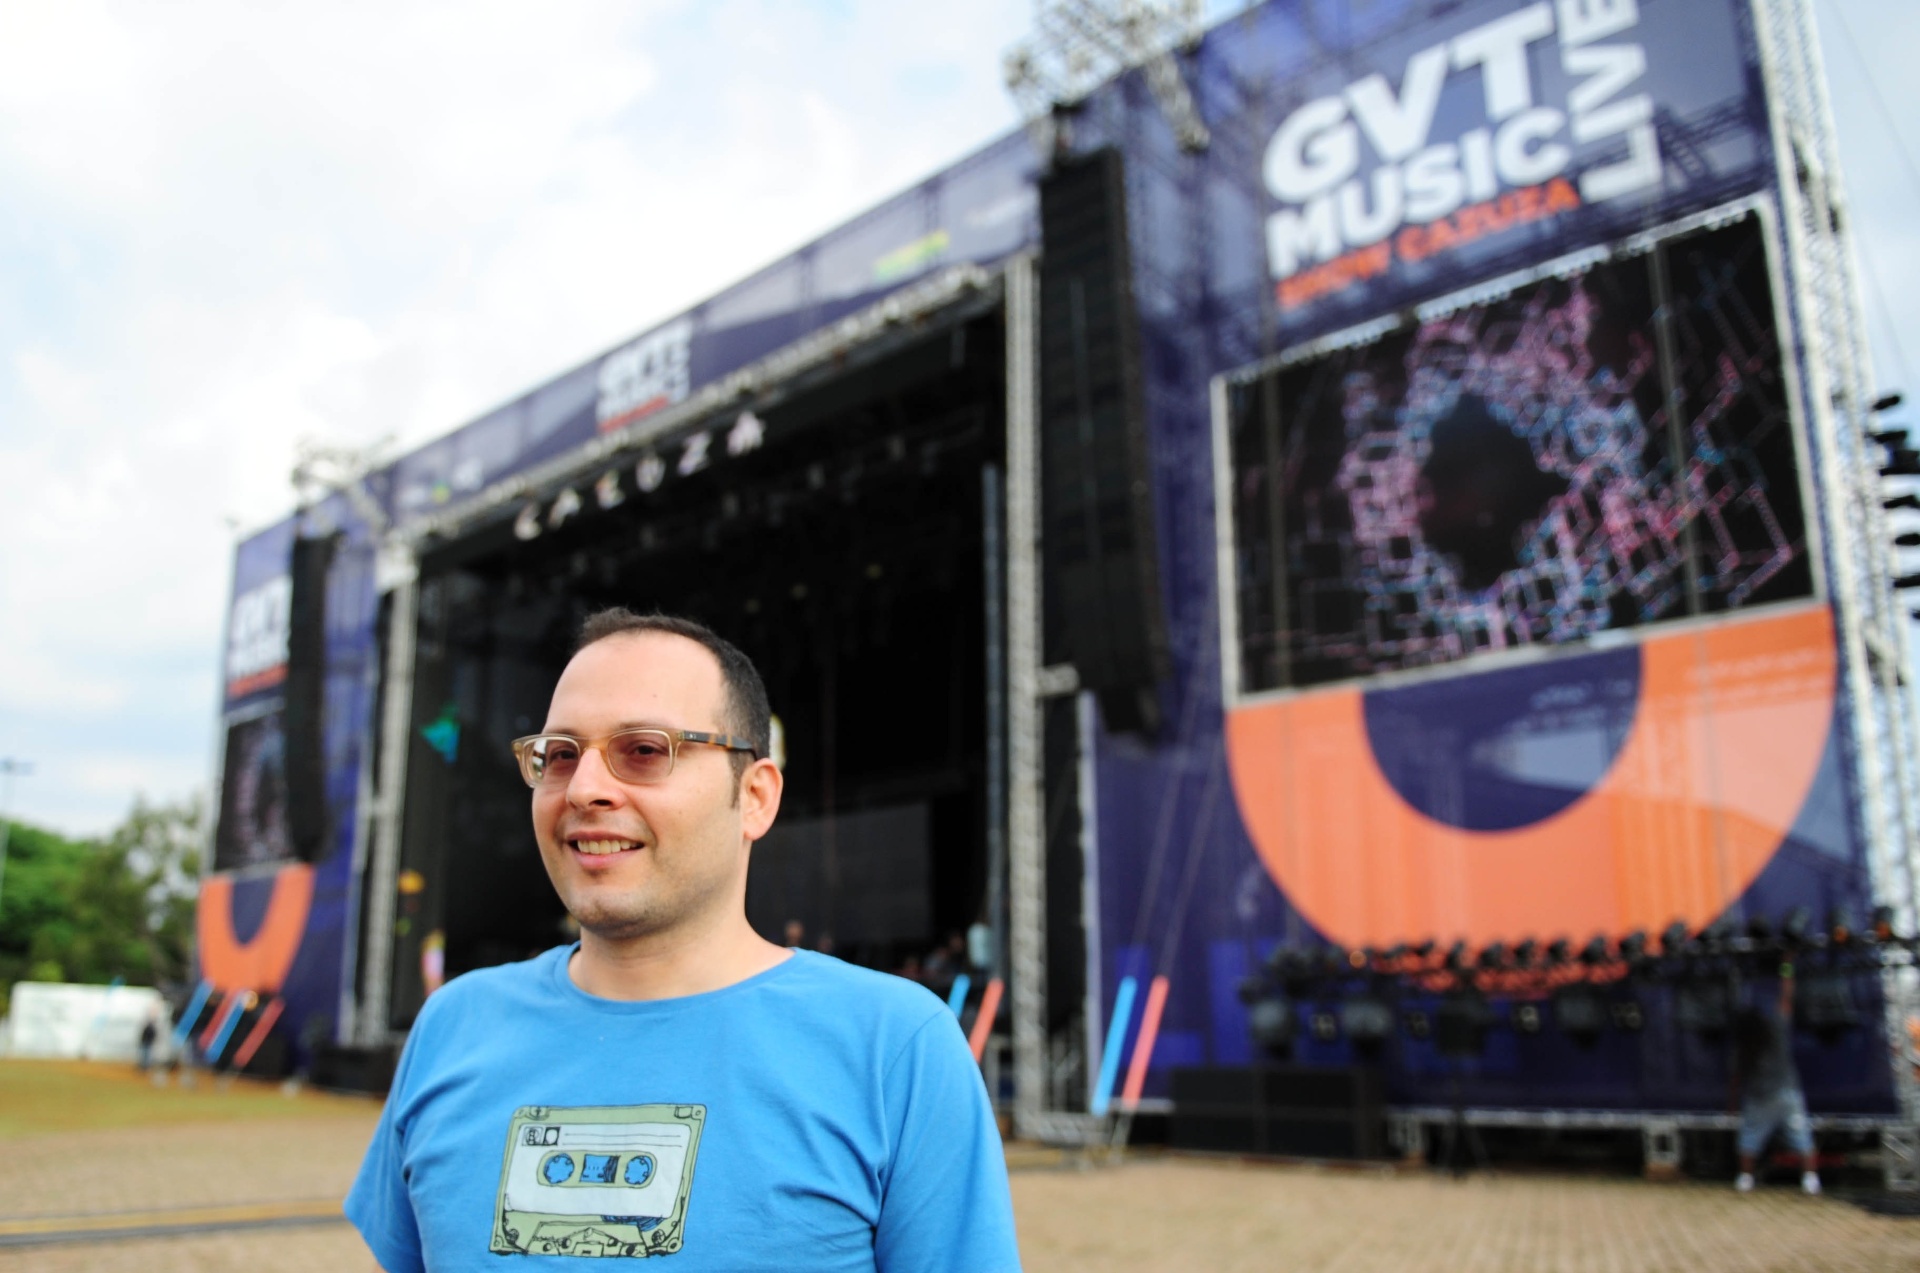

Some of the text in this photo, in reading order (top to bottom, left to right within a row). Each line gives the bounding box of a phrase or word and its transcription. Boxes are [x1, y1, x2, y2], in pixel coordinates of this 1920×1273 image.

[1265, 3, 1553, 200] GVT
[1266, 106, 1571, 278] MUSIC
[1557, 0, 1661, 201] LIVE
